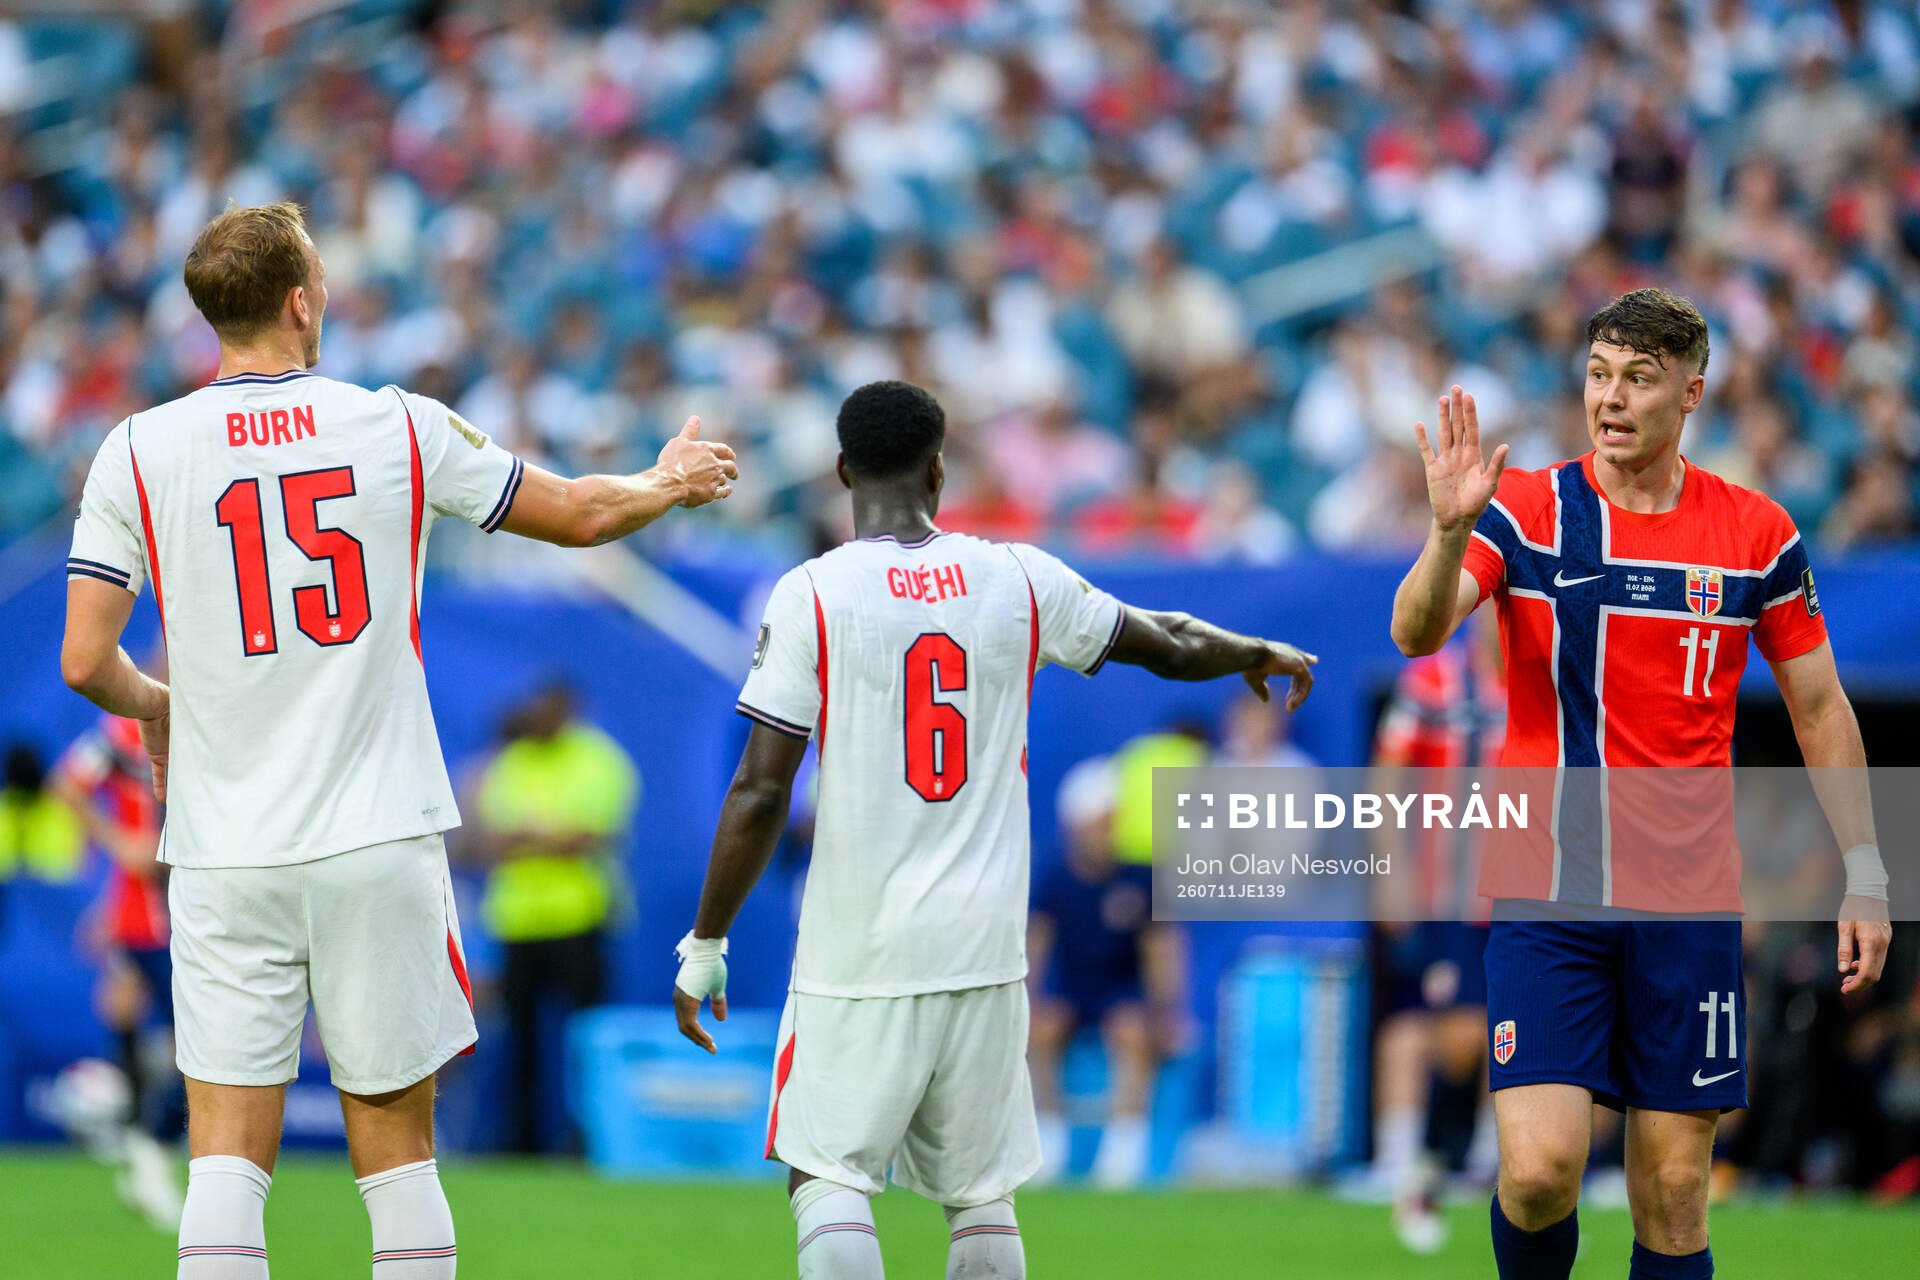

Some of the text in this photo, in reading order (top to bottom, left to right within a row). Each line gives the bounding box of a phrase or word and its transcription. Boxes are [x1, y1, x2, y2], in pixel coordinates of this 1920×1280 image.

[226, 405, 317, 447] BURN
[215, 465, 371, 656] 15
[887, 563, 967, 604] GUÉHI
[1643, 575, 1655, 583] ENG
[1632, 593, 1650, 601] MIAMI
[1679, 627, 1720, 697] 11
[904, 633, 967, 802] 6
[1699, 991, 1737, 1059] 11
